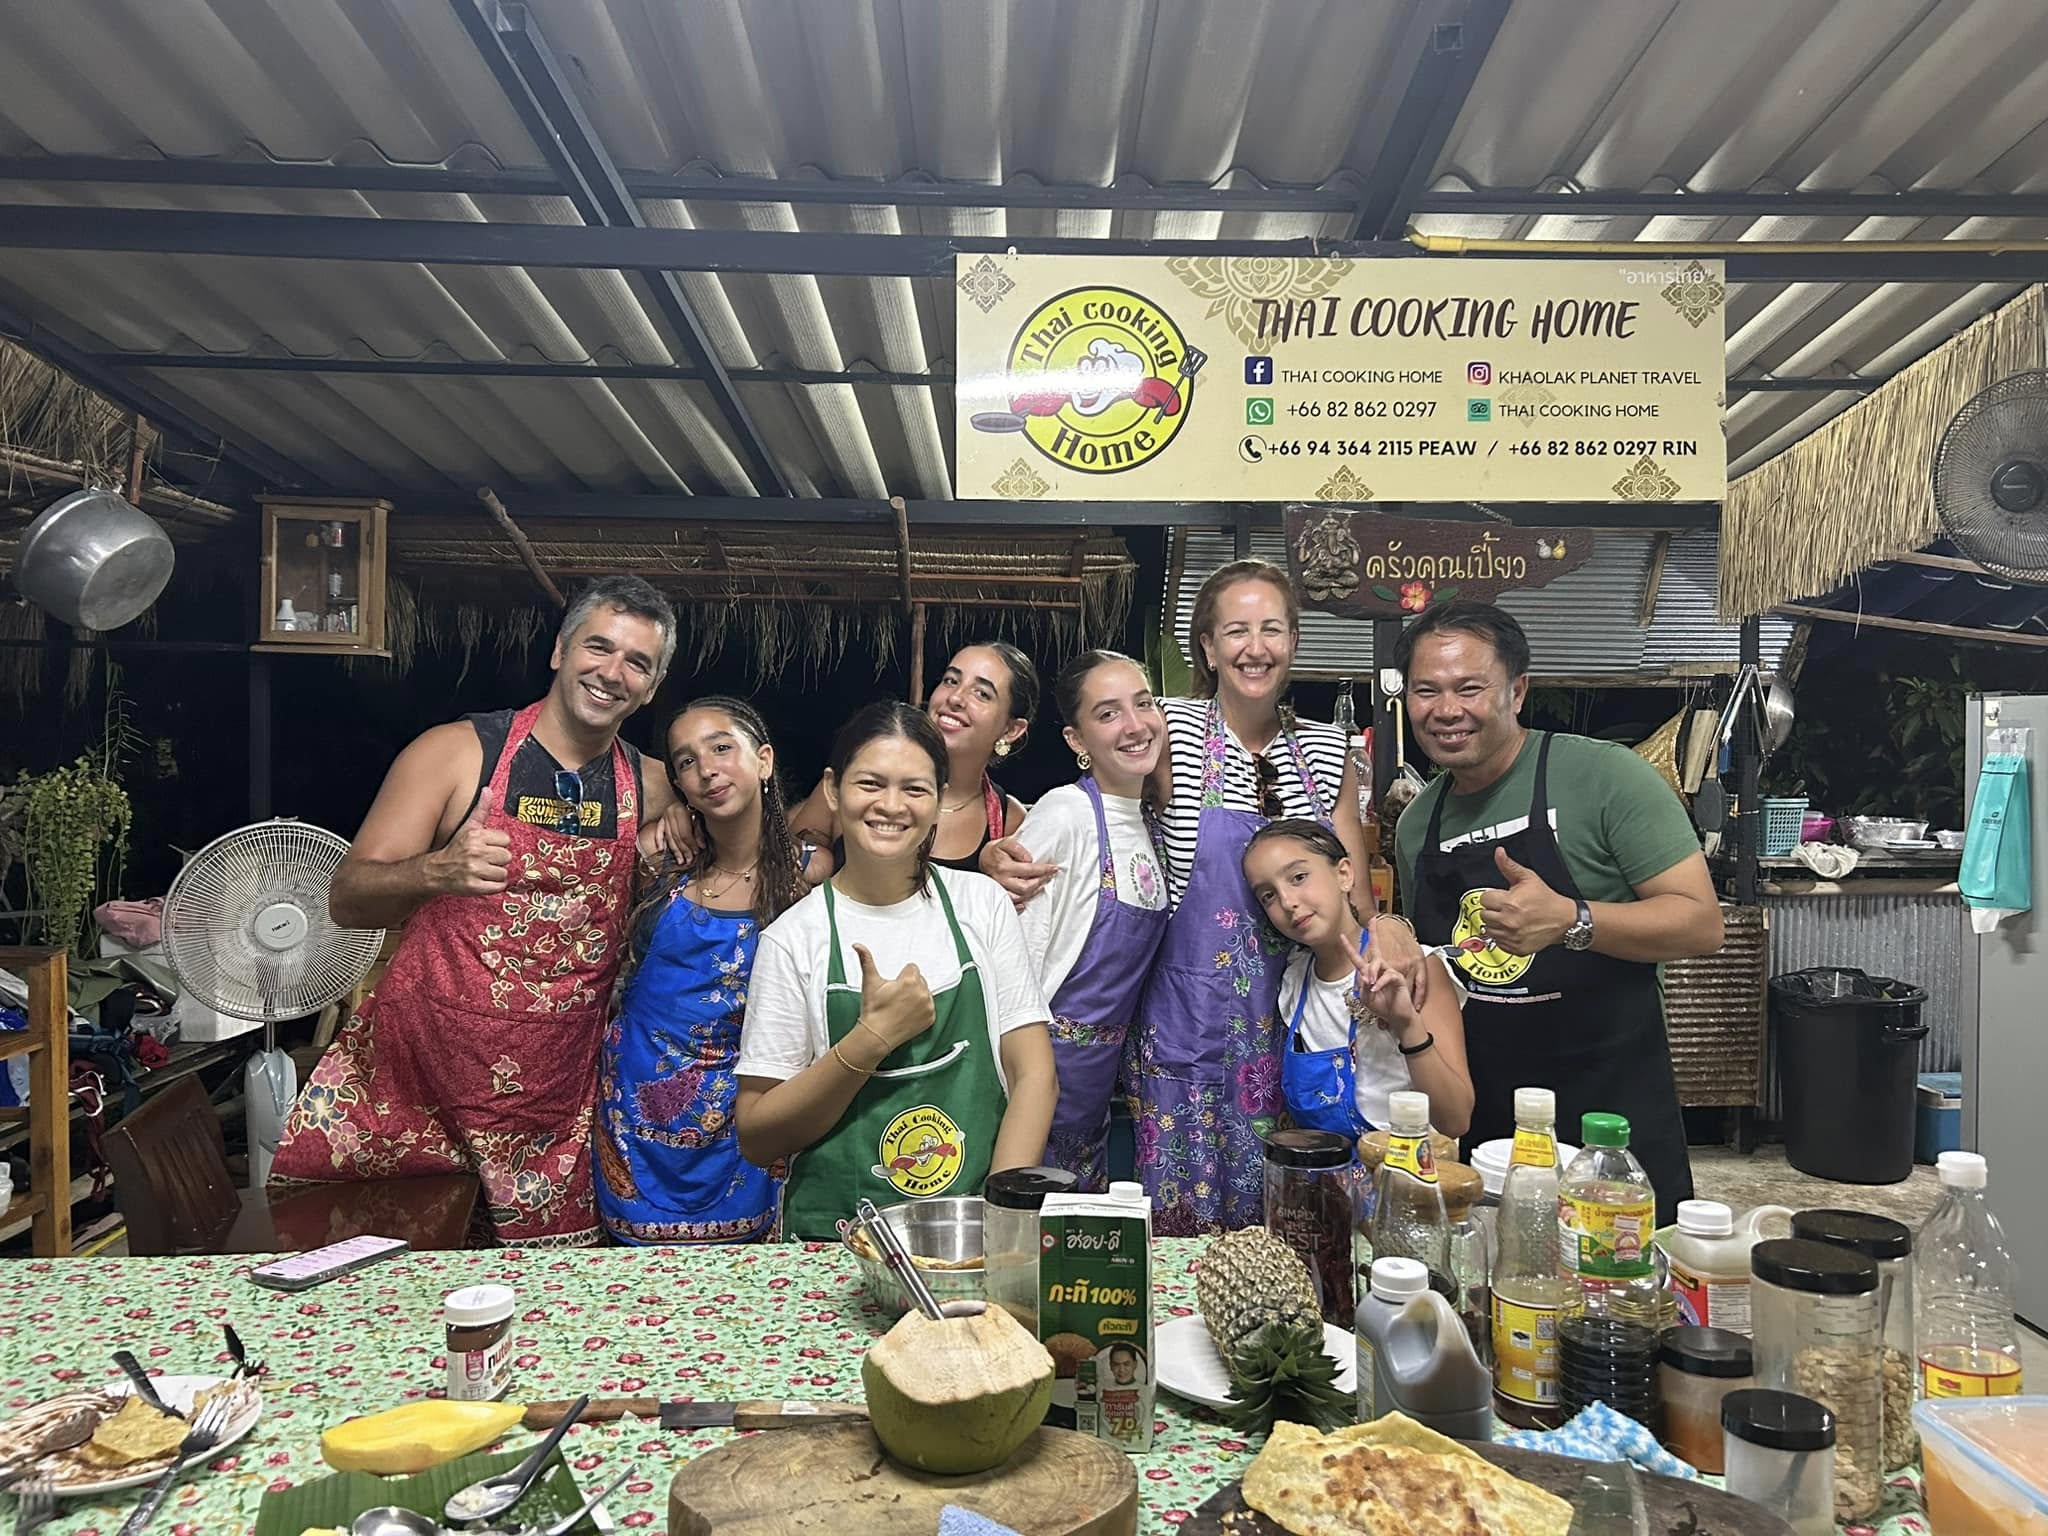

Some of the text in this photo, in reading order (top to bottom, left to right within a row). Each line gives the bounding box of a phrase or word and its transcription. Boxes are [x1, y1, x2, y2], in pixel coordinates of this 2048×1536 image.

[1252, 297, 1640, 345] THAI COOKING HOME
[1020, 306, 1074, 365] Thai
[1281, 370, 1443, 384] THAI COOKING HOME
[1499, 371, 1702, 385] KHAOLAK PLANET TRAVEL
[1287, 401, 1437, 418] +66 82 862 0297
[1499, 404, 1659, 418] THAI COOKING HOME
[1050, 427, 1156, 466] Home
[1268, 440, 1301, 456] +66
[1307, 440, 1331, 456] 94
[1337, 440, 1372, 456] 364
[1378, 440, 1413, 456] 2115
[1419, 440, 1477, 456] PEAW
[1508, 440, 1542, 456] +66
[1547, 440, 1569, 456] 82
[1574, 440, 1608, 456] 862
[1613, 440, 1657, 456] 0297
[1663, 440, 1697, 456] RIN
[1366, 531, 1526, 589] ครัวคุณเปี้ยว
[1468, 962, 1520, 979] Home
[885, 1113, 953, 1145] Thai Cooking
[903, 1170, 952, 1190] Home
[1278, 1206, 1317, 1220] SIMPLY
[1090, 1287, 1137, 1306] 100%
